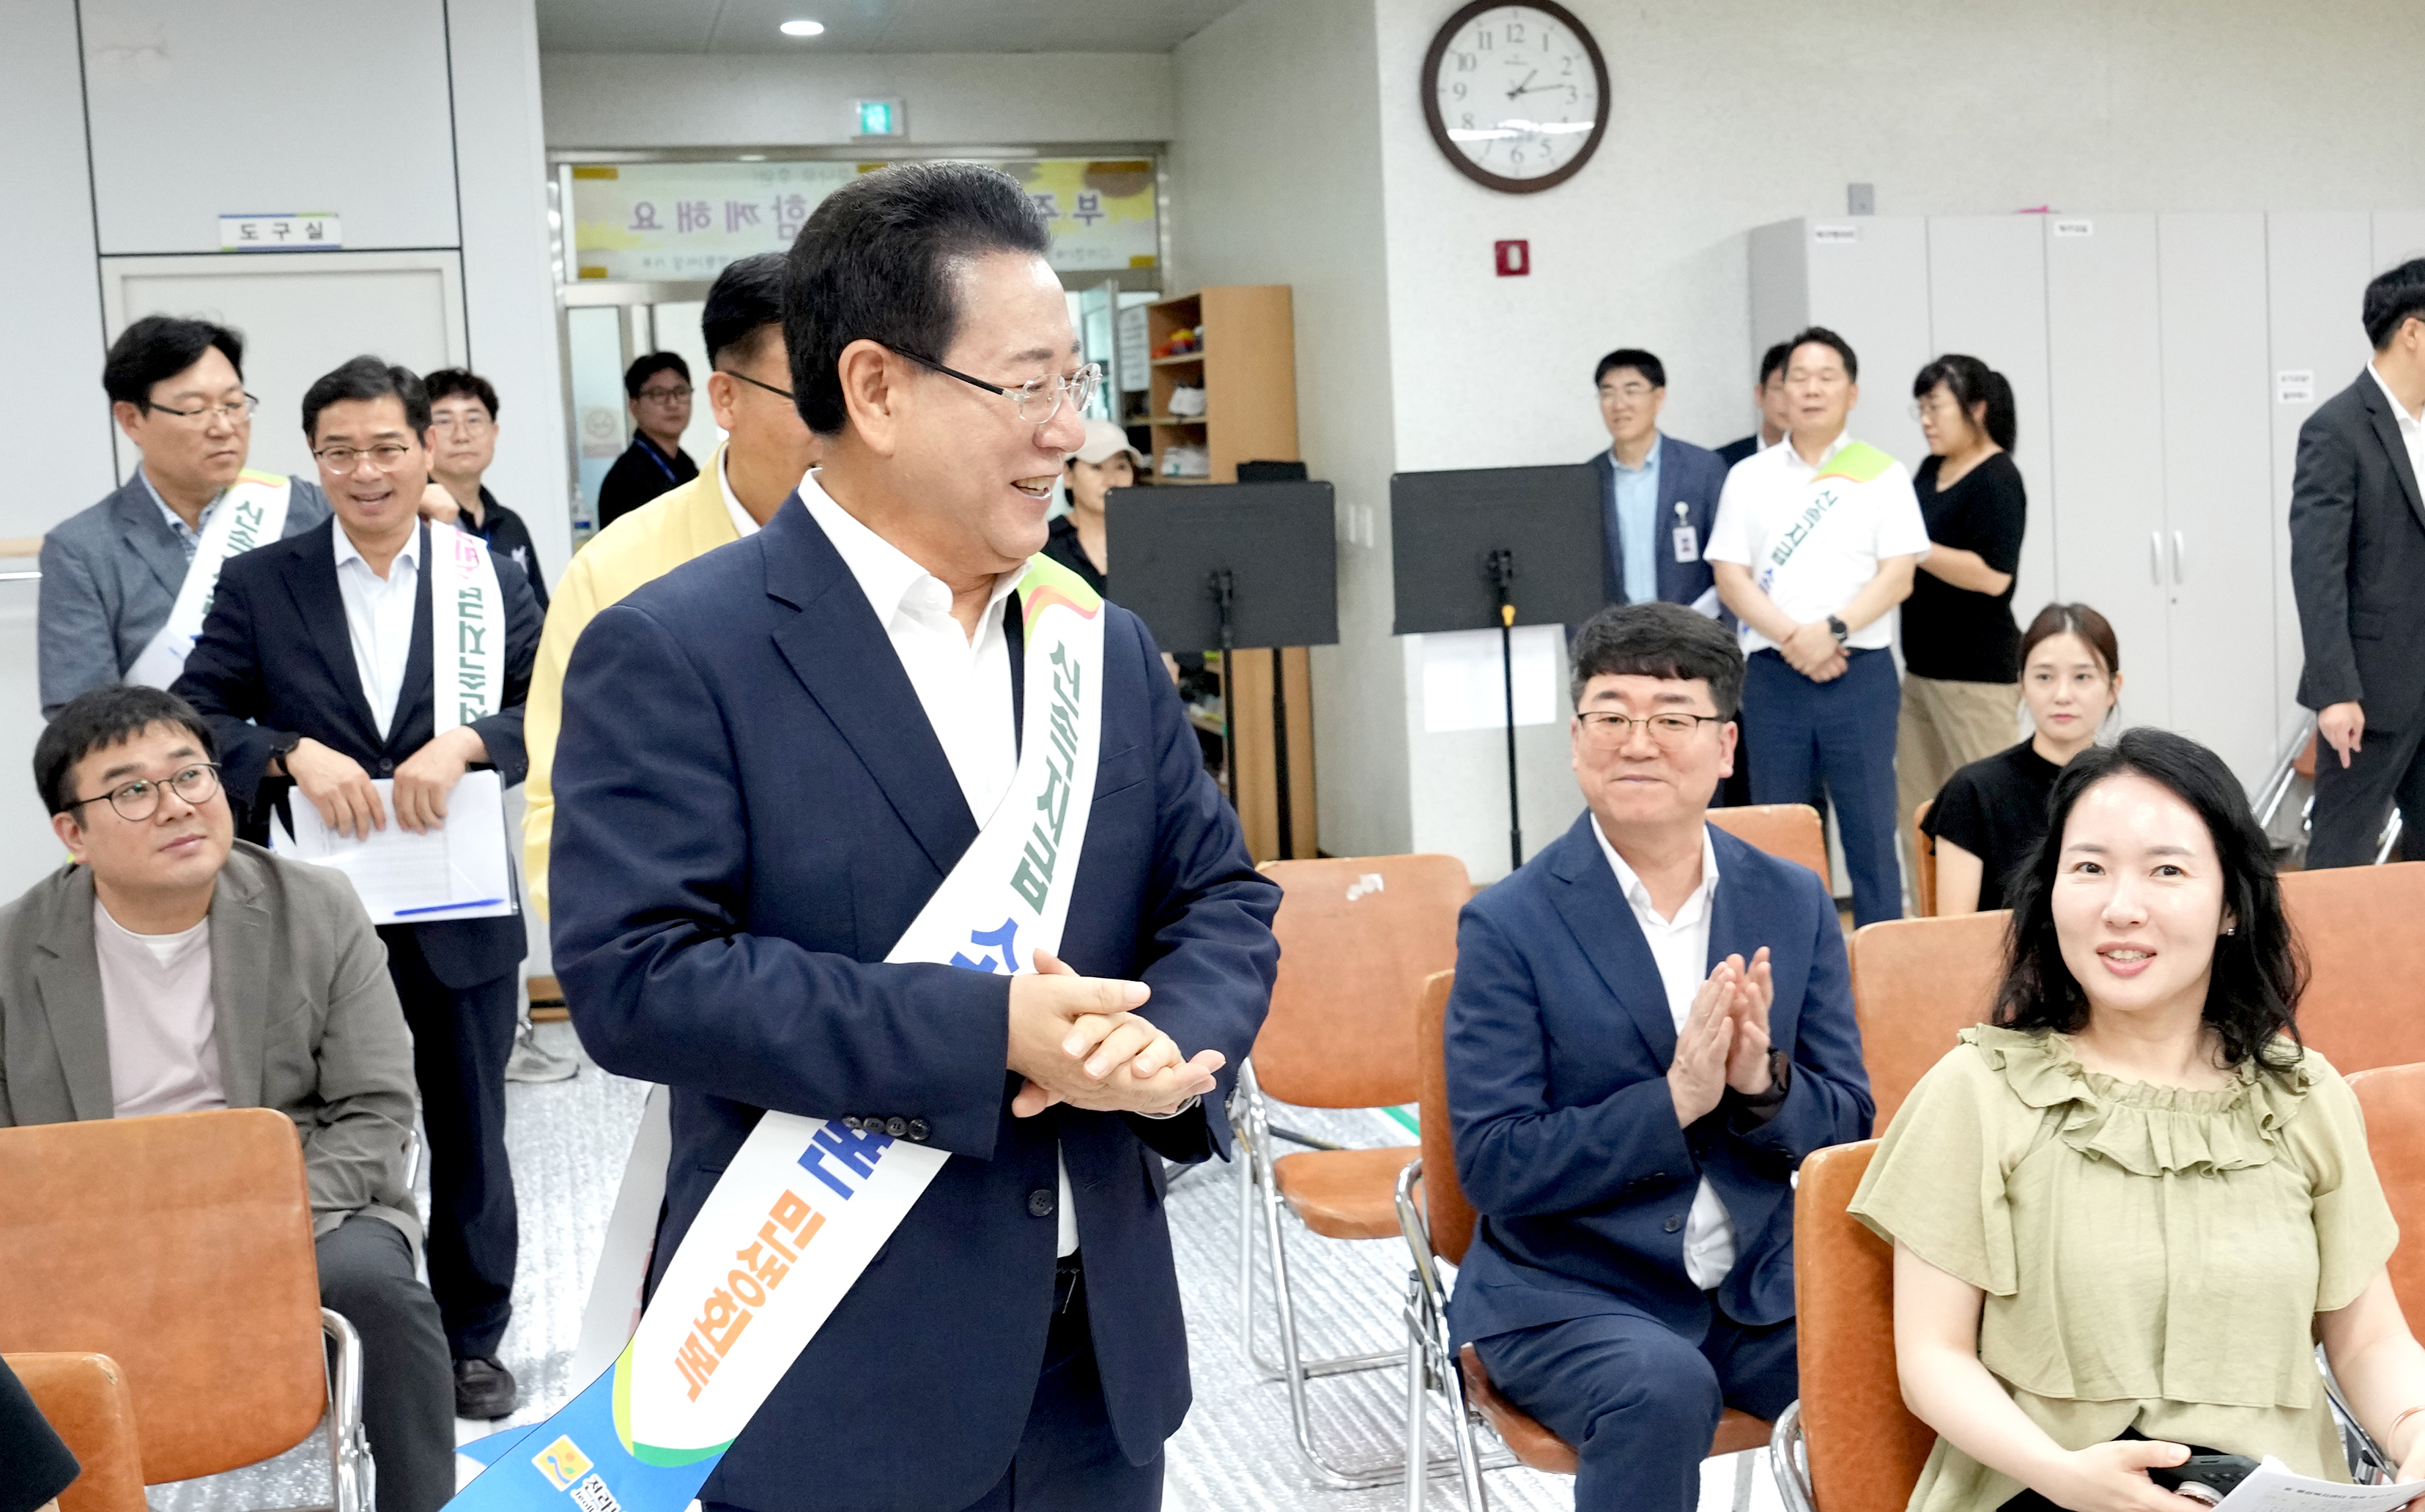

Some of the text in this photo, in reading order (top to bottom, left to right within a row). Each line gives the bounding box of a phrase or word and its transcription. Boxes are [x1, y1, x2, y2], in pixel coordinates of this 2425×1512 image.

[1478, 32, 1492, 51] 11
[1506, 23, 1525, 43] 12
[1542, 33, 1549, 52] 1
[1456, 53, 1476, 72] 10
[1561, 56, 1572, 76] 2
[1453, 83, 1467, 100] 9
[1564, 85, 1577, 104] 3
[1462, 113, 1473, 130] 8
[1511, 147, 1524, 163] 6
[1539, 140, 1552, 158] 5
[240, 221, 324, 241] 도구실
[1010, 640, 1080, 916] 신속지급
[674, 1189, 826, 1402] 민생회복
[586, 1476, 618, 1512] 전라
